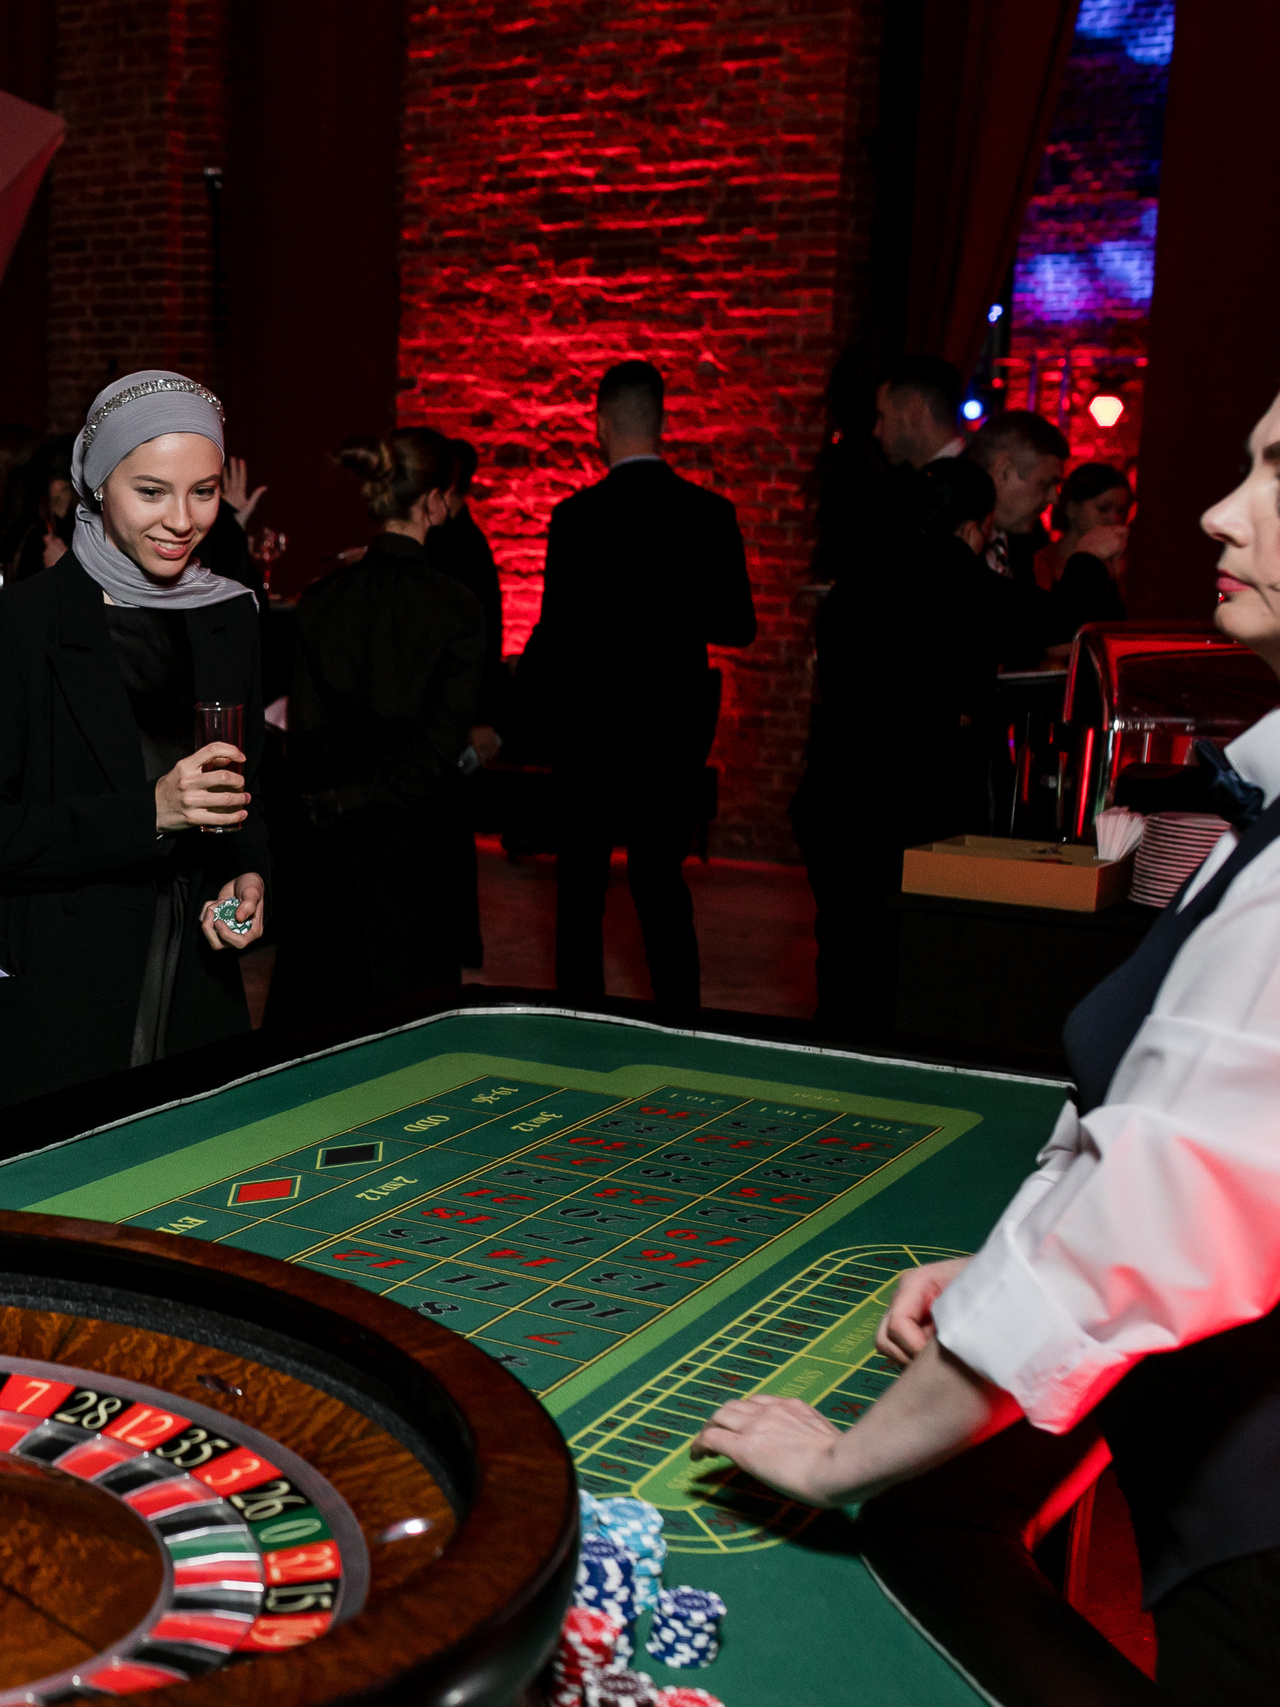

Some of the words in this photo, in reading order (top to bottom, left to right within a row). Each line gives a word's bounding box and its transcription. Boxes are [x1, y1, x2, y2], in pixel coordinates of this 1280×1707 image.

[471, 1086, 519, 1105] 19-36
[403, 1115, 451, 1132] ODD
[568, 1136, 646, 1151] 30
[693, 1135, 773, 1149] 32
[531, 1152, 613, 1166] 27
[662, 1152, 745, 1169] 29
[790, 1152, 869, 1168] 31
[494, 1169, 579, 1186] 24
[623, 1168, 717, 1186] 26
[761, 1168, 846, 1186] 28
[458, 1187, 537, 1204] 21
[592, 1188, 676, 1206] 23
[729, 1187, 817, 1205] 25
[155, 1216, 208, 1235] EV
[421, 1207, 502, 1225] 18
[557, 1207, 645, 1227] 20
[696, 1206, 786, 1226] 22
[374, 1228, 461, 1248] 15
[518, 1230, 606, 1248] 17
[664, 1228, 749, 1248] 19
[331, 1249, 416, 1269] 12
[481, 1248, 567, 1269] 14
[623, 1249, 718, 1269] 16
[437, 1272, 522, 1295] 11
[588, 1272, 679, 1295] 13
[548, 1298, 640, 1321] 10
[523, 1331, 577, 1346] 7
[15, 1380, 51, 1413] 7
[54, 1390, 122, 1431] 28
[110, 1409, 174, 1447] 12
[155, 1428, 231, 1469] 35
[204, 1458, 262, 1487] 3
[231, 1480, 308, 1521] 26
[258, 1517, 323, 1544] 0
